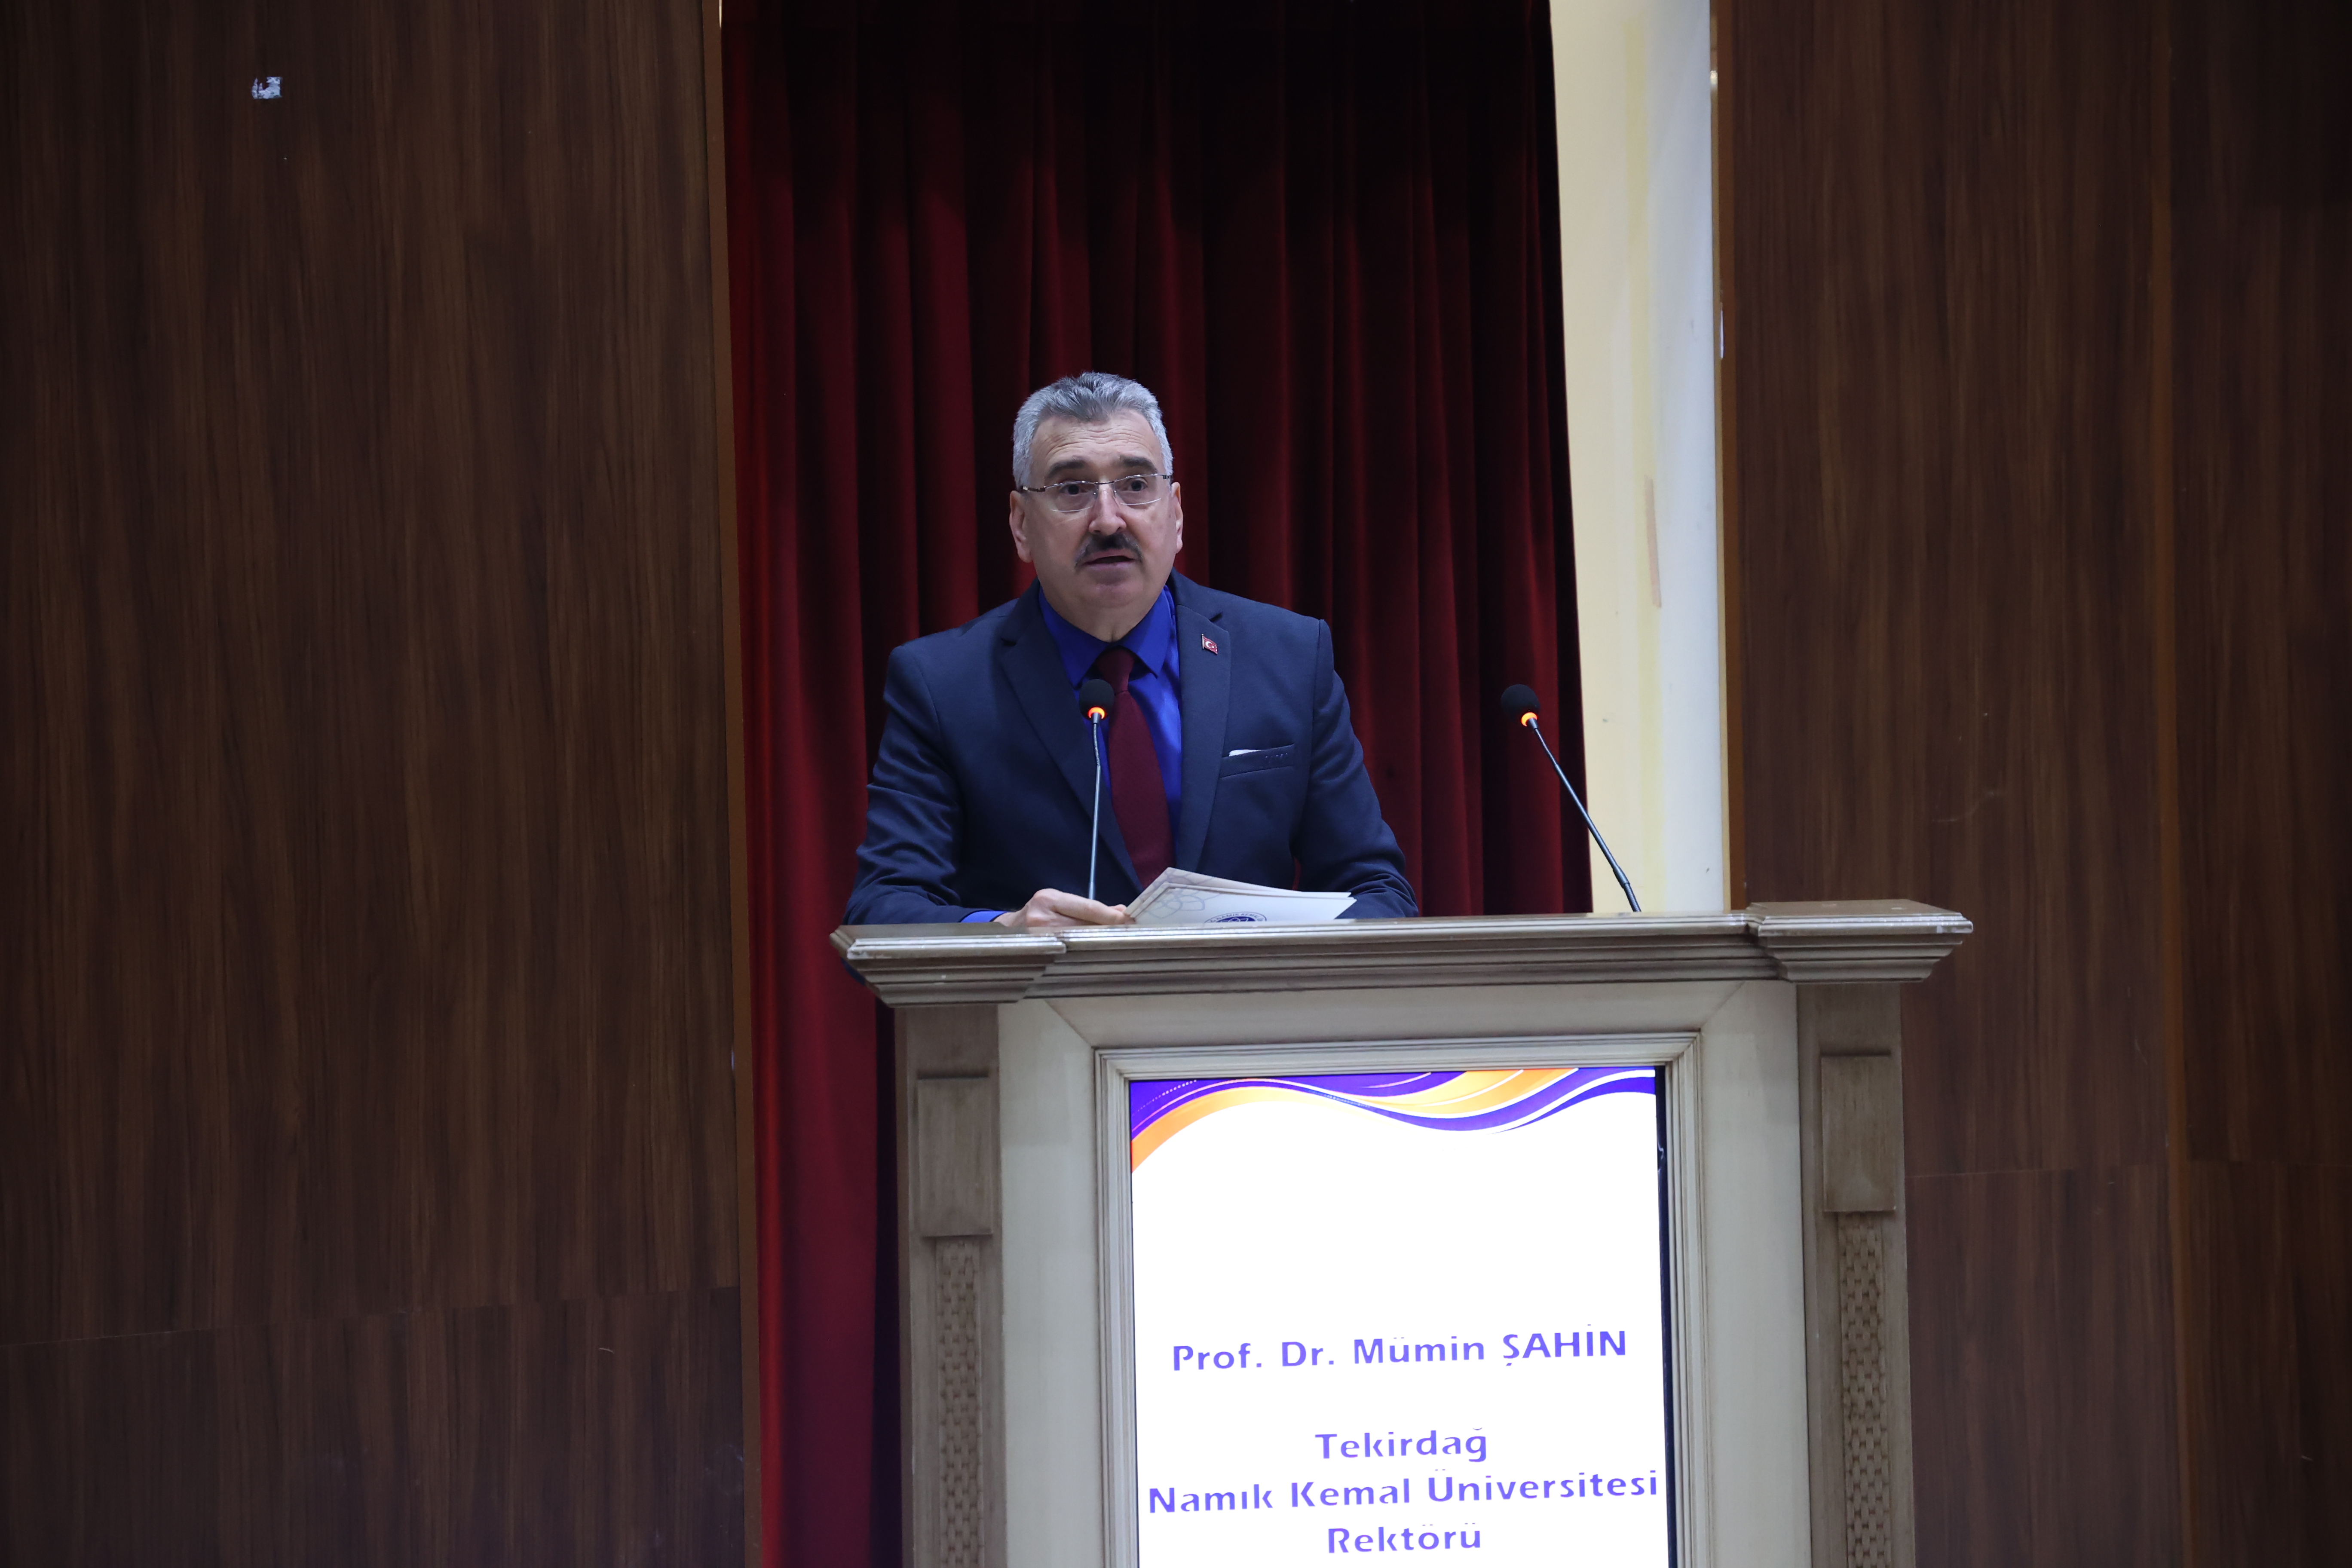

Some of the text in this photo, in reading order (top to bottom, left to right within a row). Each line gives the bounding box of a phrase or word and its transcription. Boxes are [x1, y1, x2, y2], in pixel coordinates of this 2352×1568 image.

[1173, 1323, 1626, 1372] Prof. Dr. Mümin ŞAHİN
[1314, 1427, 1487, 1463] Tekirdağ
[1148, 1468, 1657, 1514] Namık Kemal Üniversitesi
[1327, 1522, 1481, 1554] Rektörü
